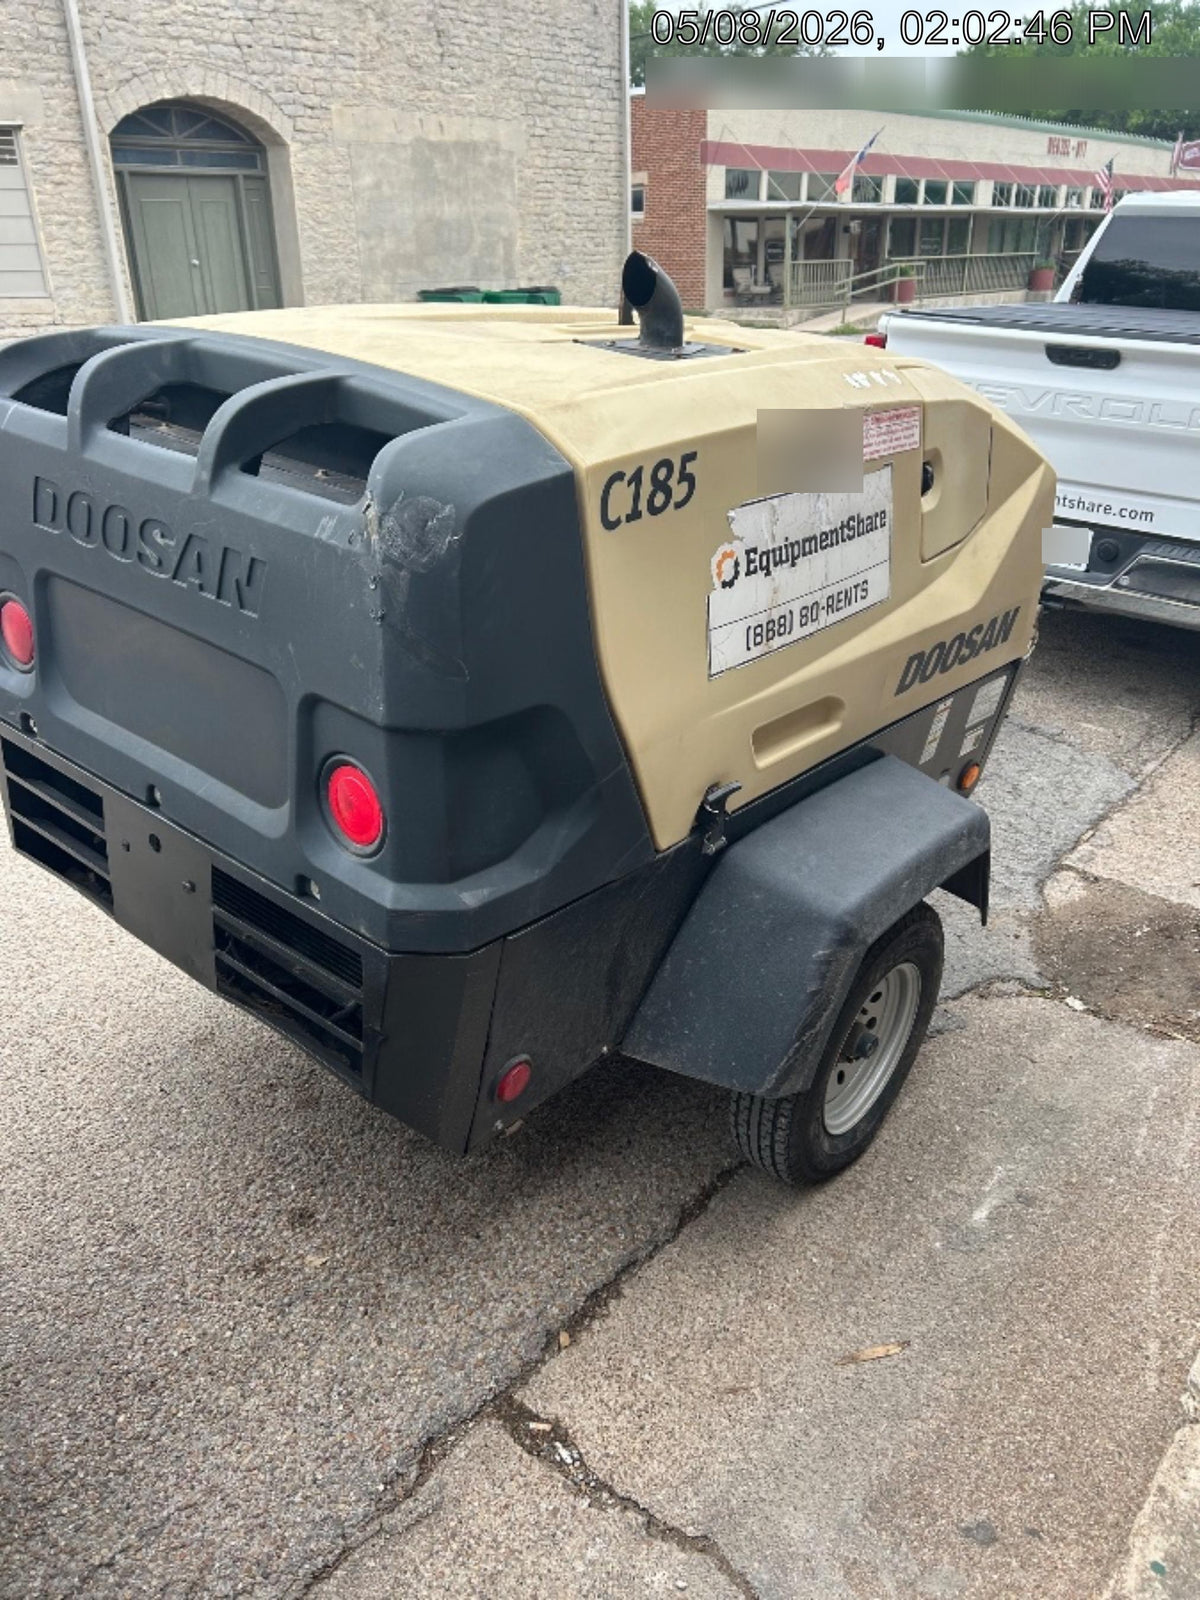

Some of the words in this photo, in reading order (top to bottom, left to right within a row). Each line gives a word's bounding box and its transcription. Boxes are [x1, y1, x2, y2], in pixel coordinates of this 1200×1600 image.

[600, 451, 698, 531] C185
[33, 475, 268, 619] DOOSAN
[744, 509, 887, 578] EquipmentShare
[746, 609, 794, 651] (888)
[799, 580, 869, 628] 80-RENTS
[894, 606, 1021, 697] DOOSAN
